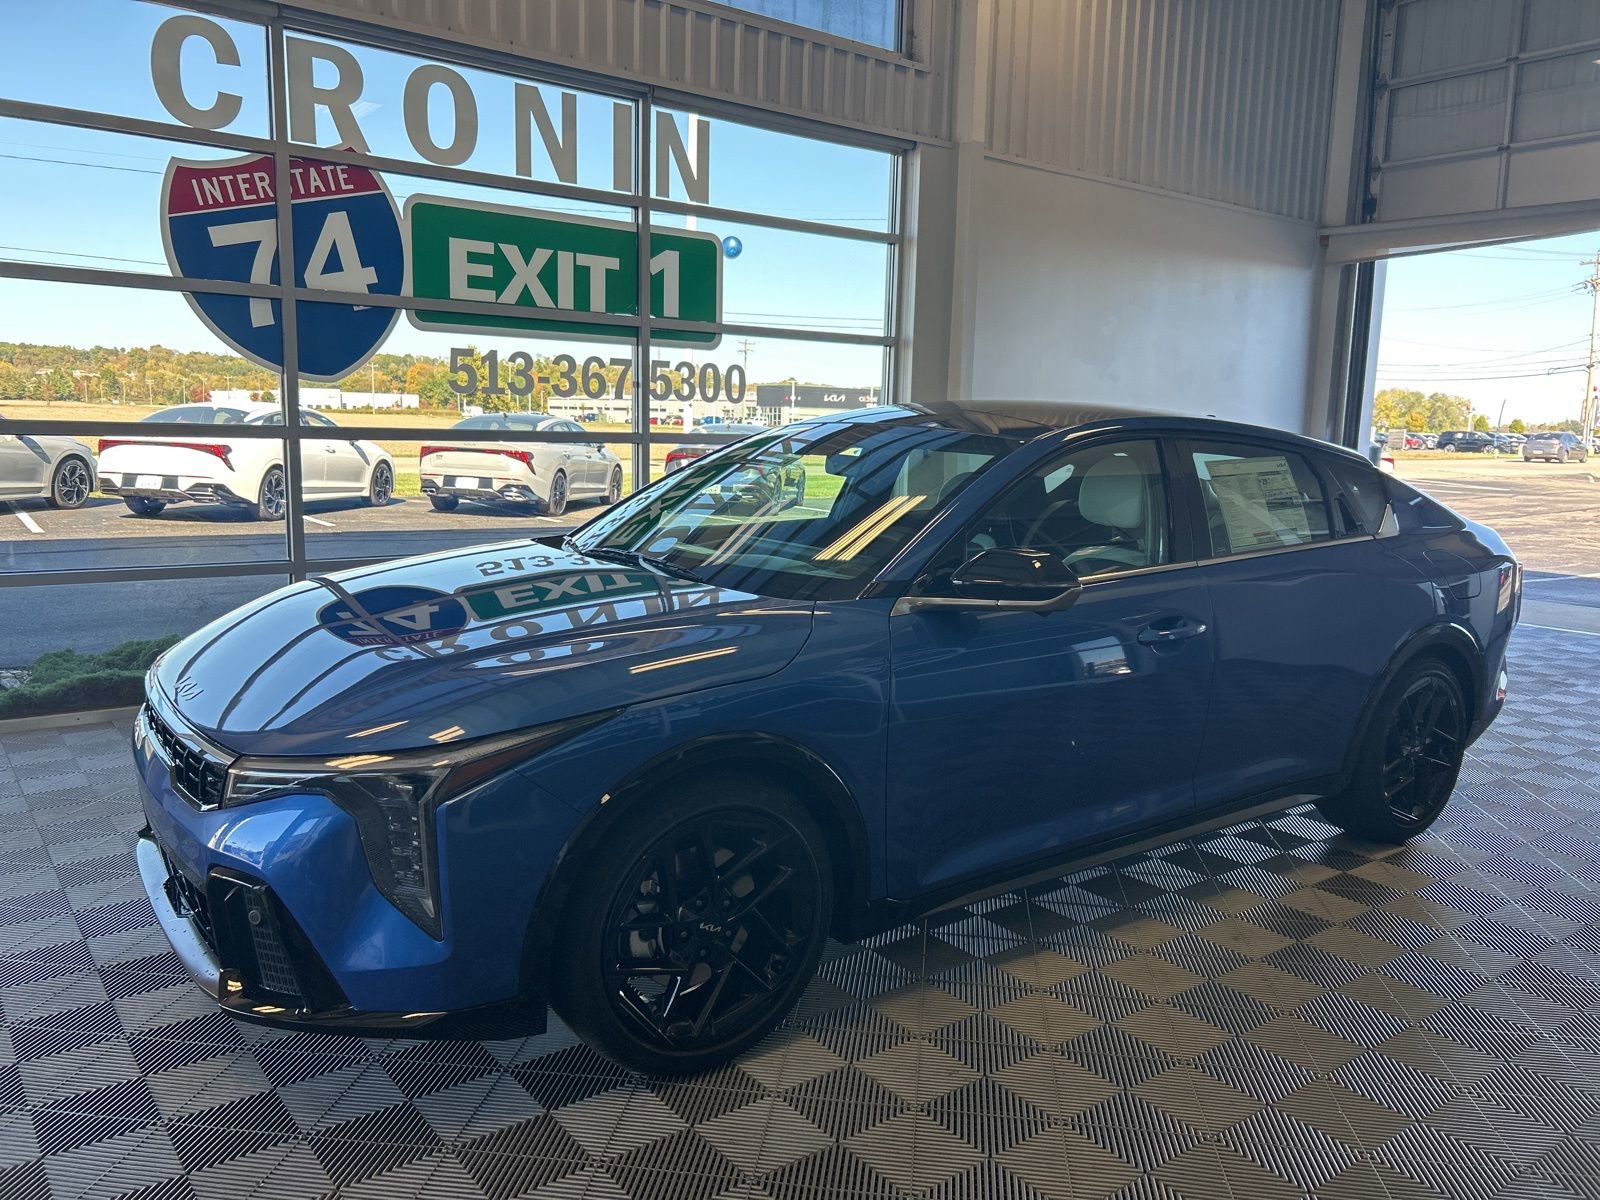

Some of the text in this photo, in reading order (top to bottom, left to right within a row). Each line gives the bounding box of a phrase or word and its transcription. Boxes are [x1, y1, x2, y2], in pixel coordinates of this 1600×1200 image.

[150, 14, 711, 205] CRONIN
[191, 165, 354, 206] INTERTATE
[207, 211, 379, 328] 74
[448, 236, 680, 318] EXIT 1
[823, 394, 846, 402] KIA
[700, 922, 722, 932] KIA
